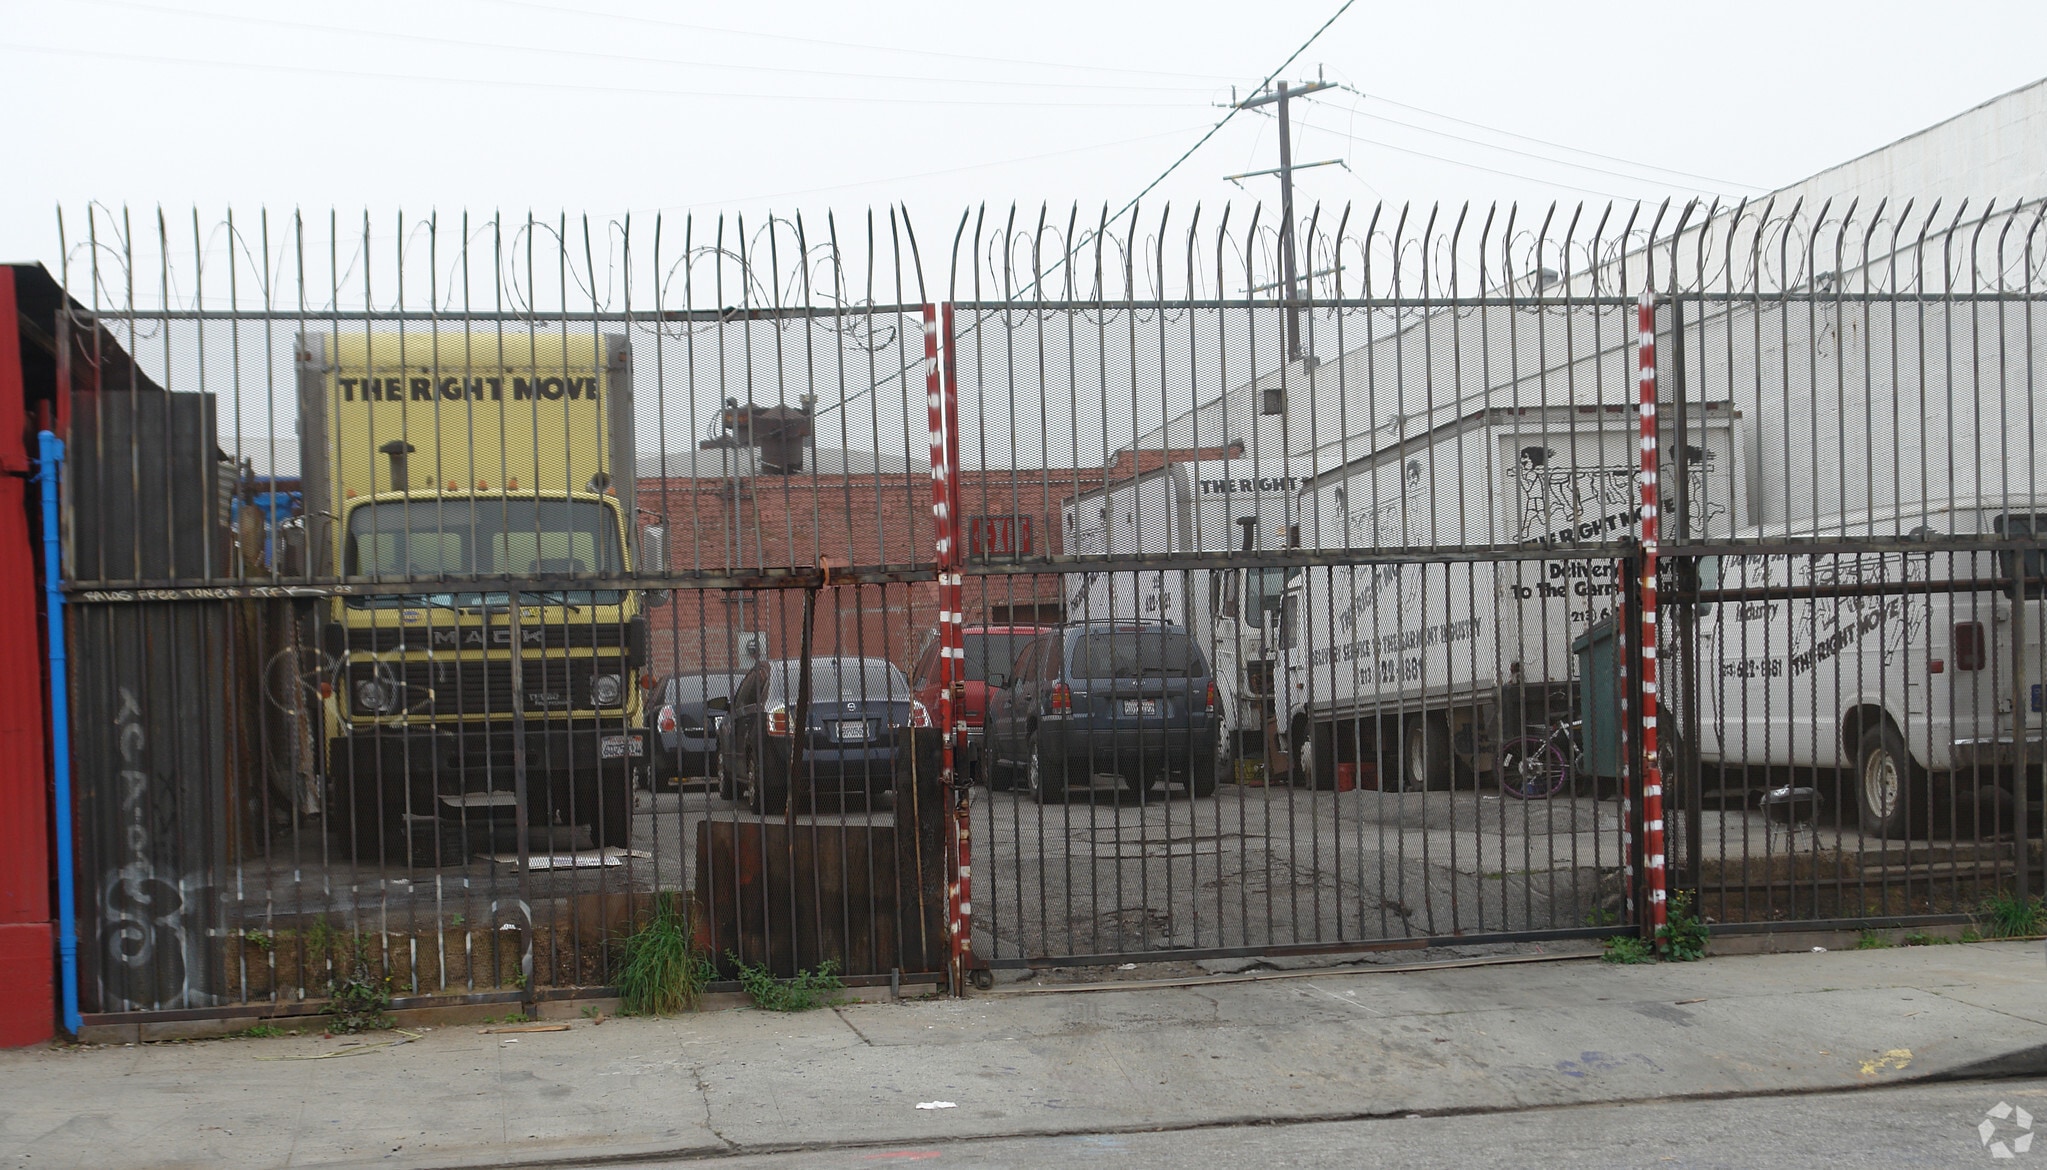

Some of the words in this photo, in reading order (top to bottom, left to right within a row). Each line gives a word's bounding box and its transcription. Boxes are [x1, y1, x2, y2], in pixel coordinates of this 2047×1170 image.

[339, 377, 401, 401] THE
[514, 377, 598, 401] MOVE
[1201, 480, 1237, 495] THE
[1619, 497, 1676, 527] MOE
[978, 519, 1027, 553] EXIT
[1355, 572, 1384, 618] RIGT
[1574, 579, 1619, 597] Garm
[433, 630, 544, 645] MACK
[1440, 617, 1482, 644] INDUSTY
[1816, 623, 1856, 663] RIGHT
